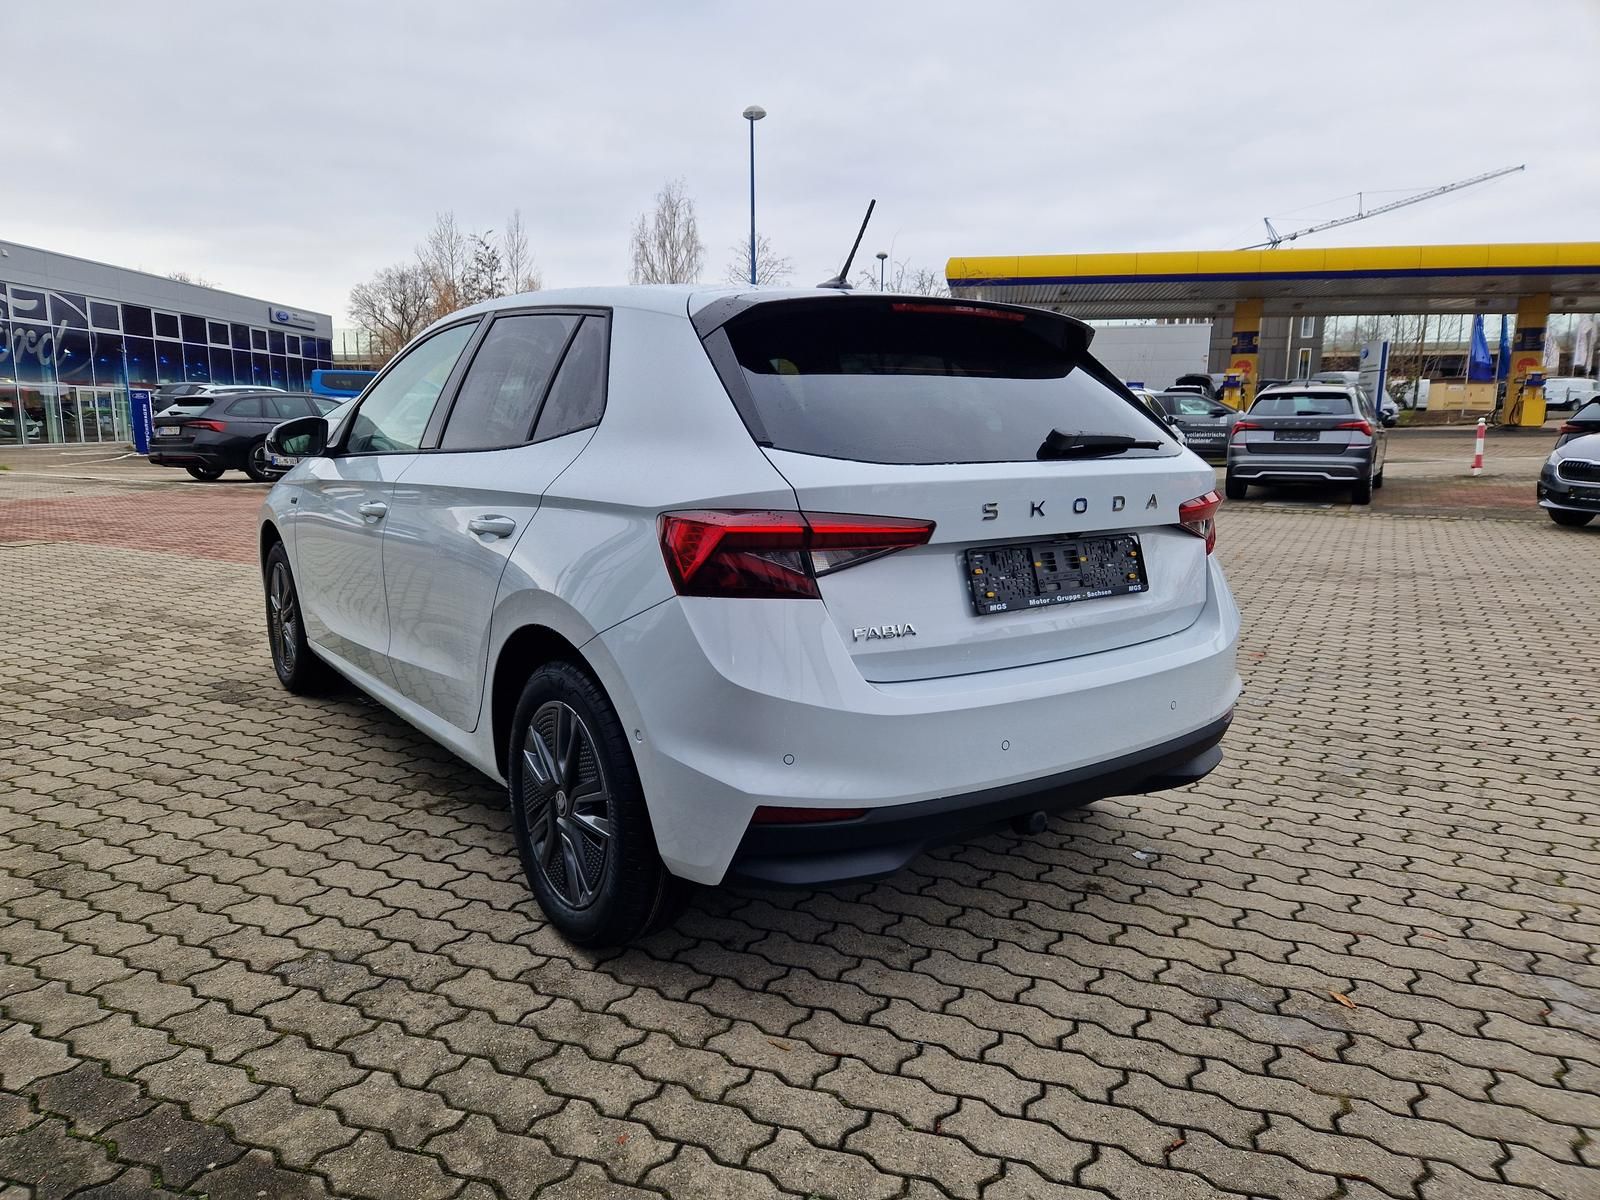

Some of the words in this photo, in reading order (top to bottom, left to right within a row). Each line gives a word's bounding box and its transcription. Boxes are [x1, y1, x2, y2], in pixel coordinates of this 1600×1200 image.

[982, 493, 1158, 521] SKODA
[1128, 584, 1142, 592] MGS
[1029, 598, 1050, 606] Motor
[1056, 593, 1081, 602] Gruppe
[1086, 589, 1112, 598] Sachsen
[989, 602, 1007, 612] MGS
[853, 623, 916, 642] FABIA
